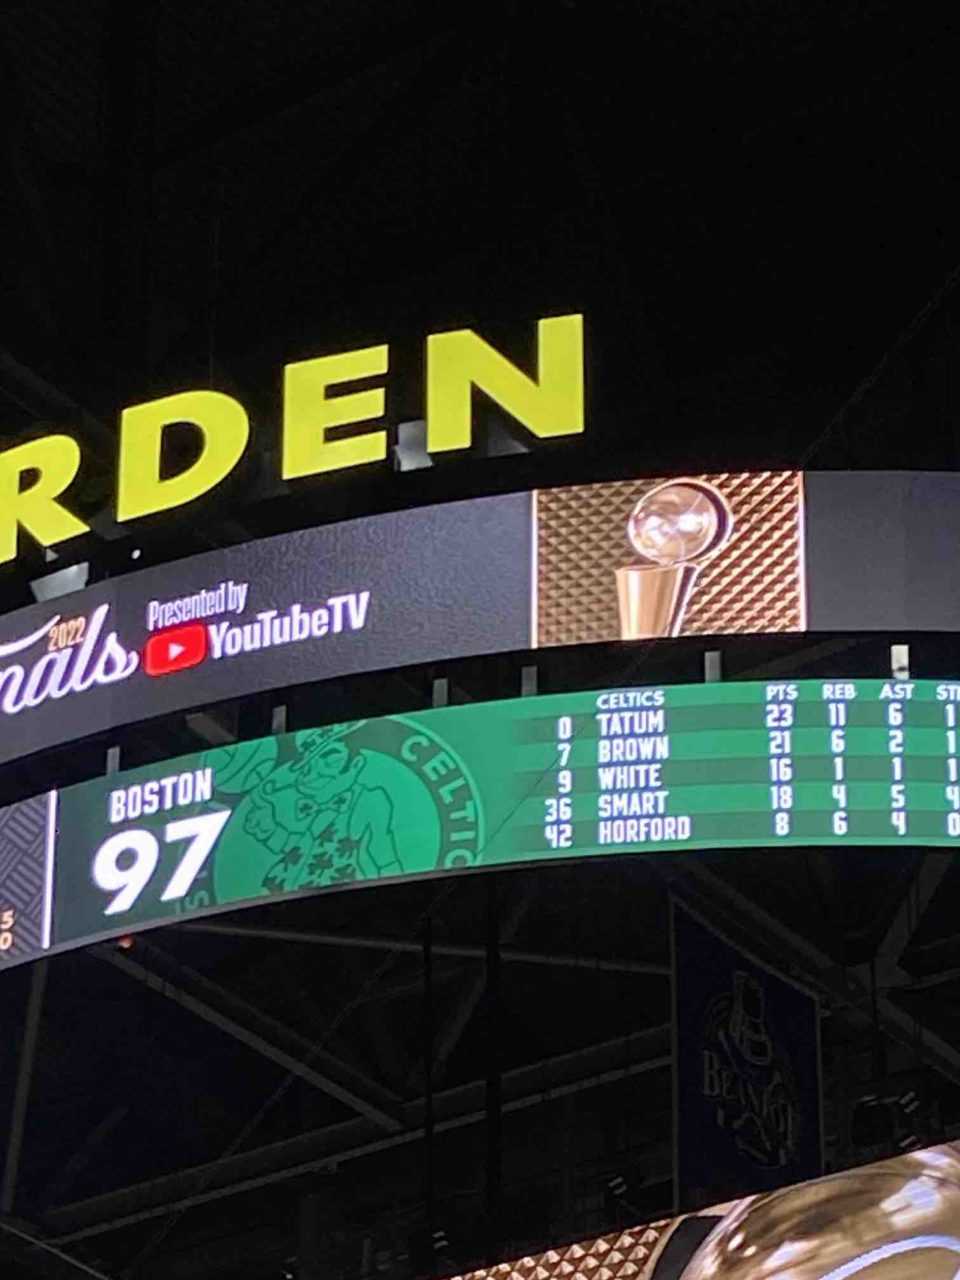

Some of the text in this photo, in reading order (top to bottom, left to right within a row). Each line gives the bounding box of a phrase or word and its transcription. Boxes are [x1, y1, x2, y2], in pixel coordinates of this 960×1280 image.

[147, 581, 248, 630] Presented by
[48, 617, 84, 651] 2022
[596, 690, 664, 709] CELTICS
[766, 684, 797, 701] PTS
[822, 683, 855, 699] REB
[878, 683, 914, 699] AST
[557, 704, 955, 739] 0 TATUM 23 11 6 1
[557, 730, 956, 766] 7 BROWN 21 6 2 1
[558, 757, 957, 793] 9 WHITE 16 1 1 1
[108, 768, 212, 823] BOSTON
[545, 785, 960, 822] 36 SMART 18 4 5 4
[545, 812, 960, 848] 42 HORFORD 8 6 4 0
[92, 808, 231, 916] 97
[0, 910, 14, 929] 5
